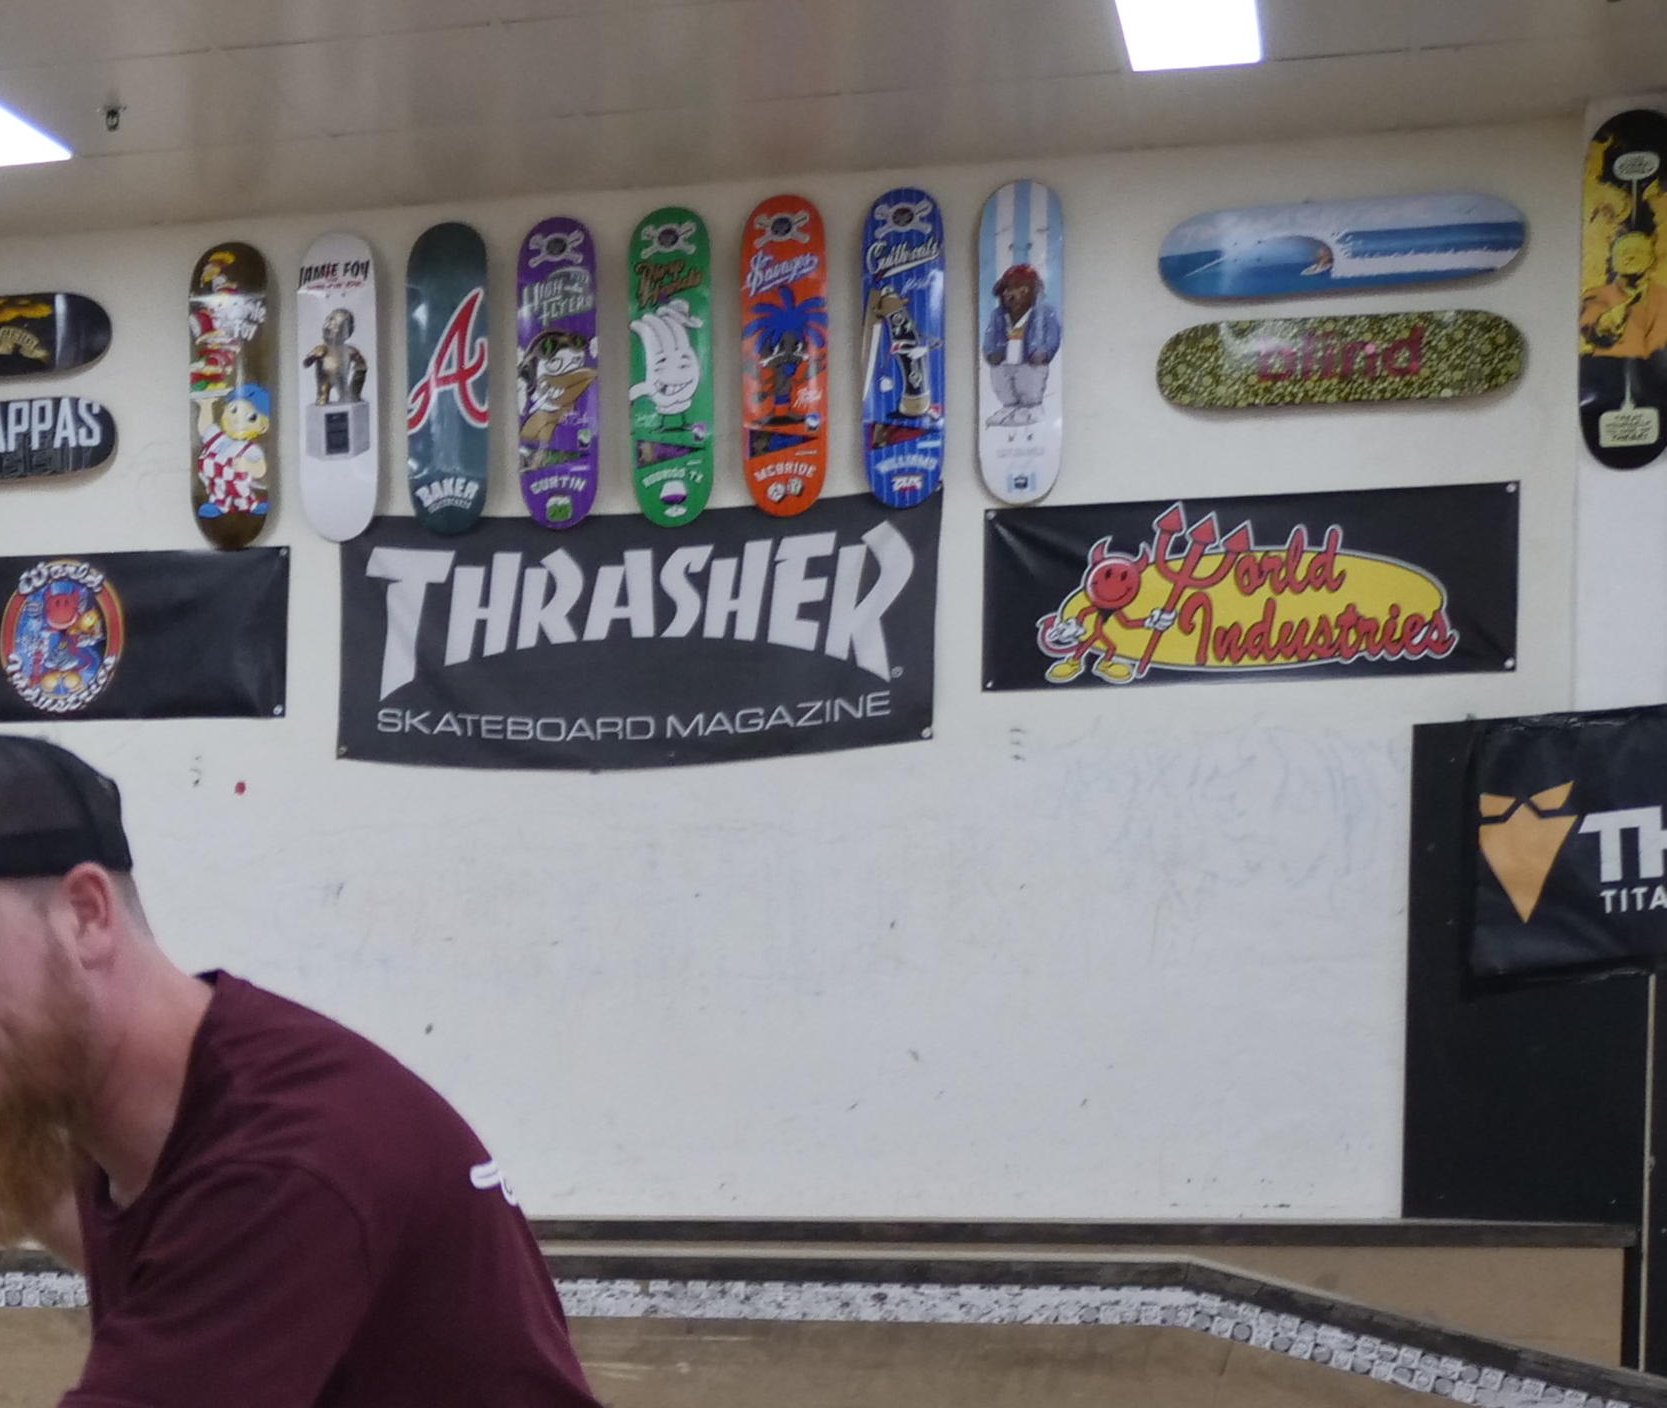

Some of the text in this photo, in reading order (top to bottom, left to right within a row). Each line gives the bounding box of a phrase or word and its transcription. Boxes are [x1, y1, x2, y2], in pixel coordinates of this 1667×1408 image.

[299, 261, 339, 288] JAMIE
[342, 260, 370, 281] FOY
[1257, 324, 1425, 382] blind
[415, 477, 480, 503] BAKER
[366, 520, 914, 701] THRASHER
[1178, 591, 1459, 666] Industries
[377, 690, 892, 742] SKATEBOARD MAGAZINE
